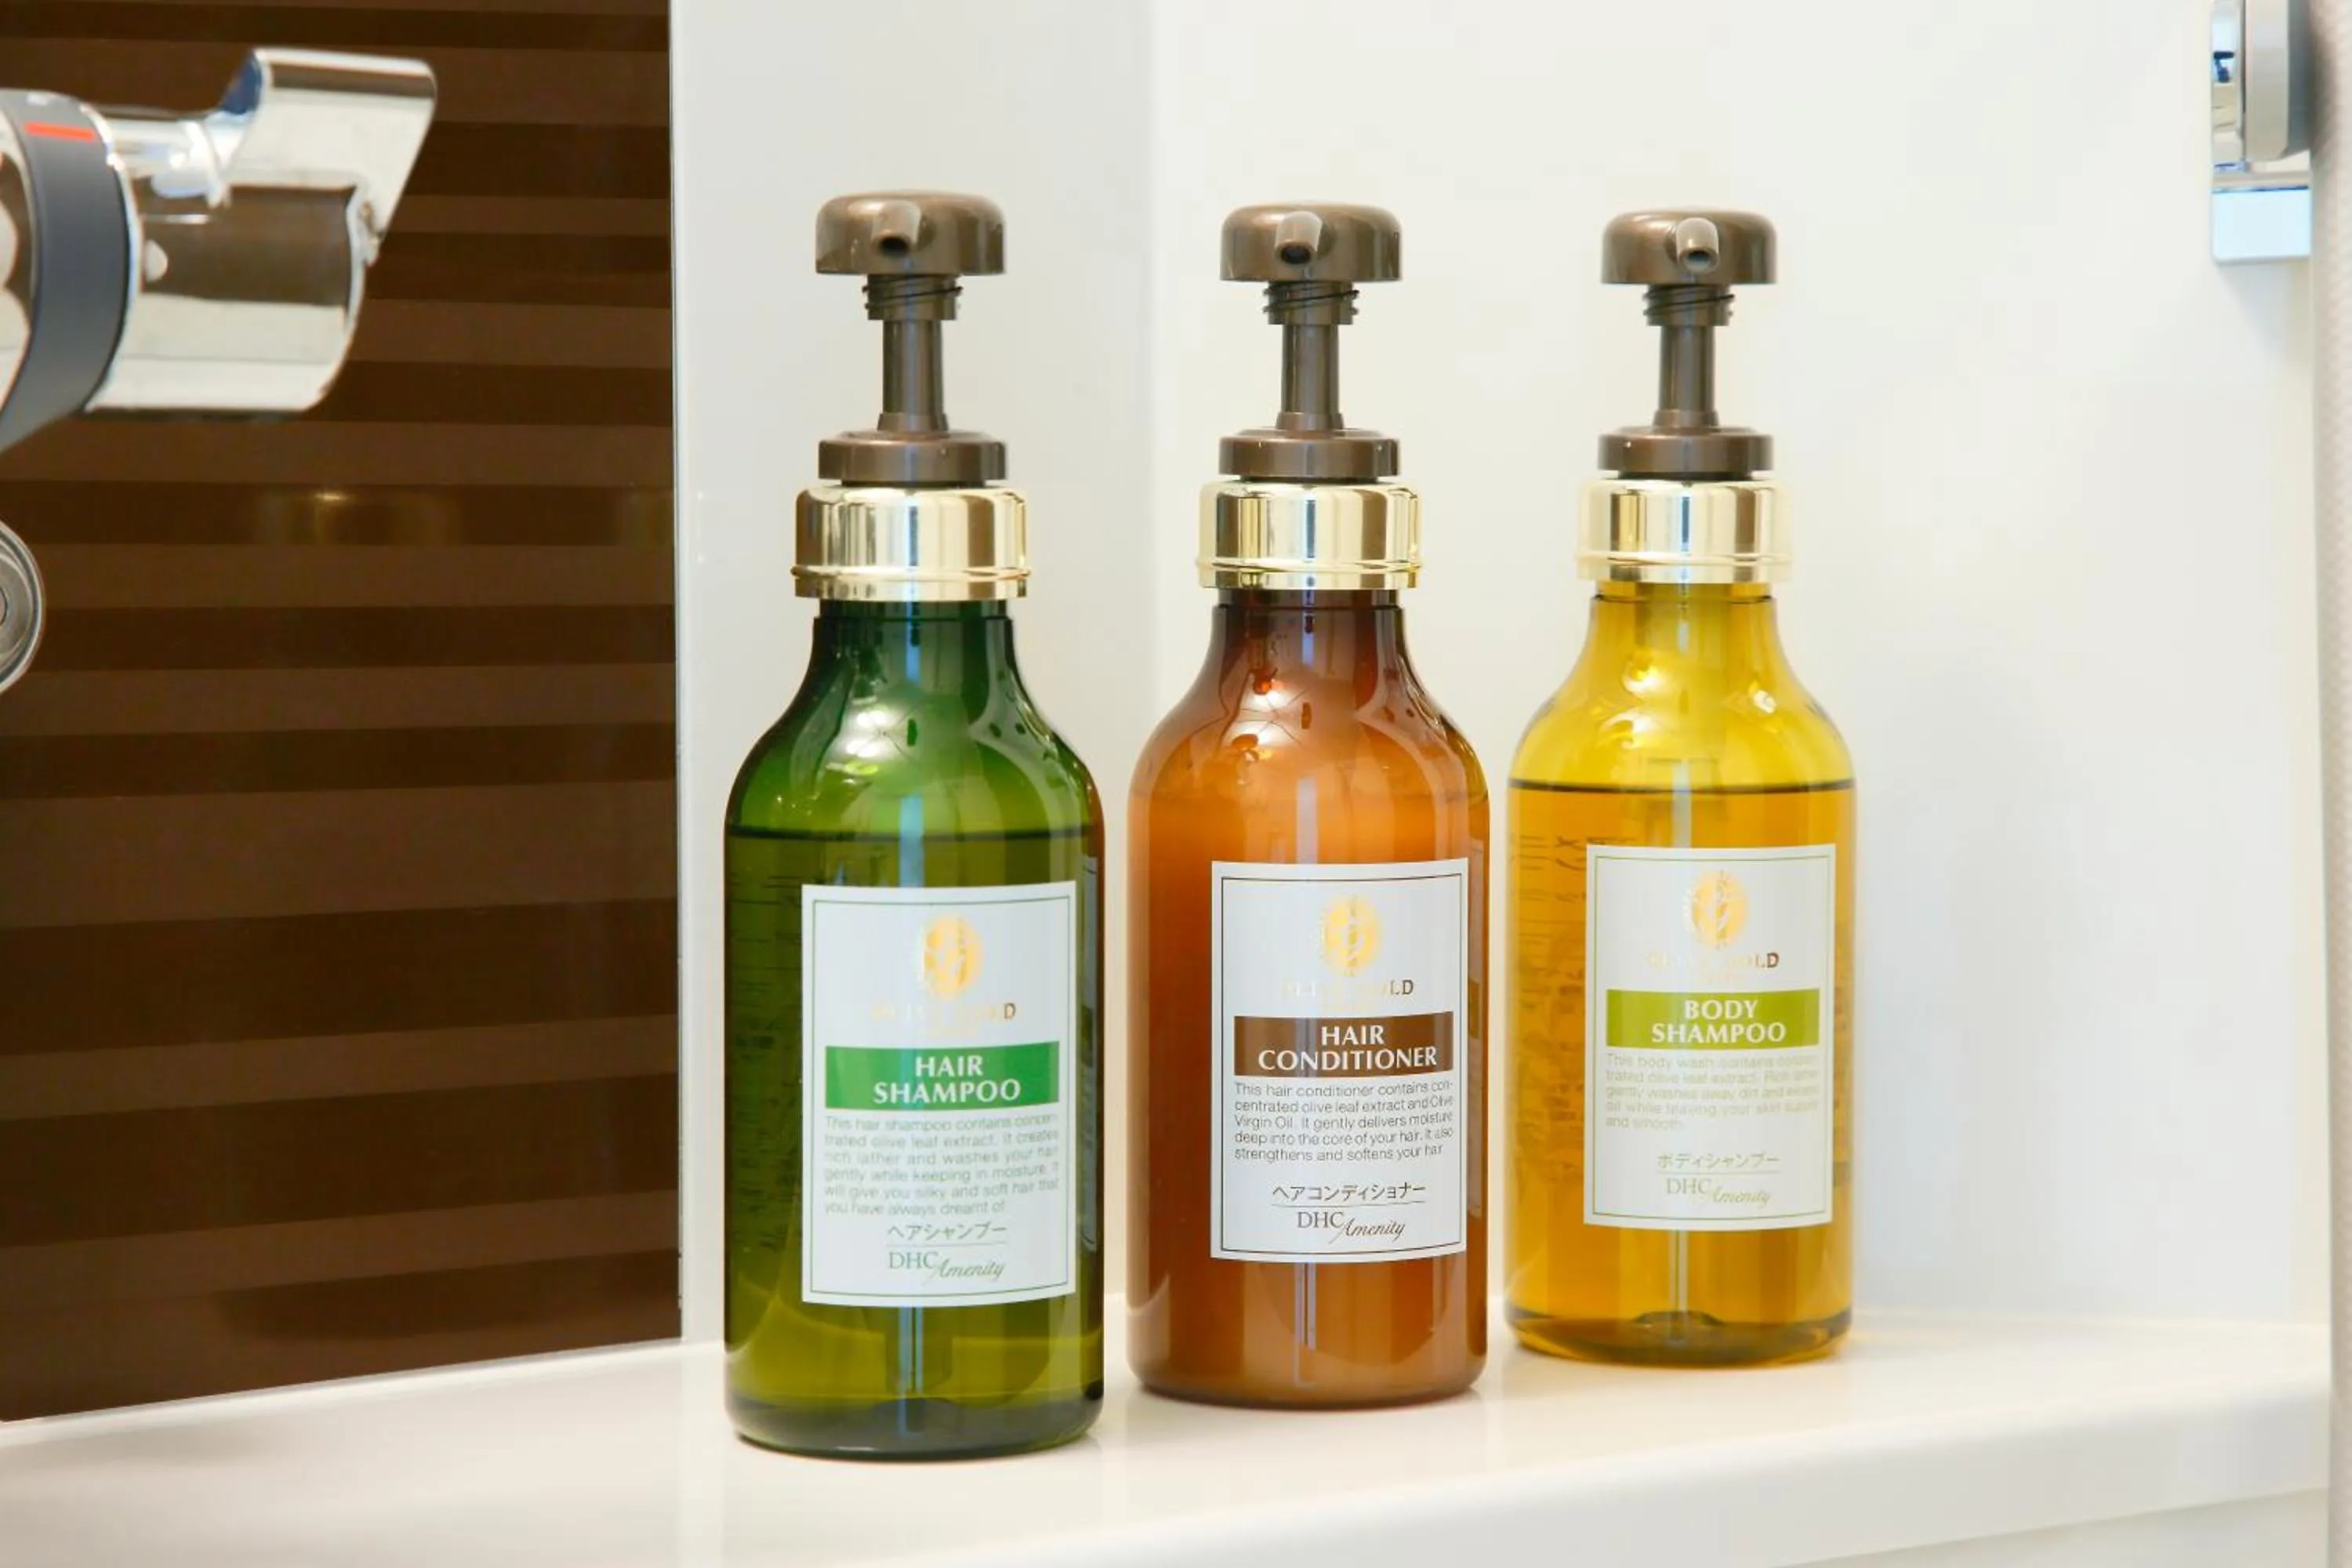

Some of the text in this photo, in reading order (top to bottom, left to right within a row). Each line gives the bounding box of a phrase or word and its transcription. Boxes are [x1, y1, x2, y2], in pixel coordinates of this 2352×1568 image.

[1685, 1000, 1759, 1019] BODY
[1321, 1025, 1385, 1045] HAIR
[1651, 1022, 1786, 1044] SHAMPOO
[915, 1055, 983, 1077] HAIR
[1258, 1046, 1437, 1070] CONDITIONER
[873, 1079, 1021, 1104] SHAMPOO
[1234, 1082, 1261, 1095] This
[1266, 1085, 1291, 1096] hair
[1296, 1085, 1374, 1098] conditioner
[1378, 1082, 1428, 1096] contains
[1235, 1100, 1298, 1113] centrated
[1301, 1101, 1332, 1113] olive
[1335, 1101, 1359, 1113] leaf
[1362, 1098, 1406, 1113] extract
[1409, 1096, 1427, 1109] and
[886, 1119, 952, 1132] shampoo
[956, 1116, 1011, 1131] contains
[1234, 1116, 1272, 1131] Virgin
[1313, 1116, 1355, 1133] gently
[1358, 1114, 1406, 1128] delivers
[1235, 1131, 1268, 1145] deep
[1298, 1133, 1319, 1145] the
[1370, 1134, 1396, 1145] your
[907, 1152, 936, 1166] and
[942, 1151, 998, 1165] washes
[1234, 1148, 1312, 1163] strengthens
[1316, 1149, 1344, 1161] and
[1347, 1145, 1392, 1161] softens
[1396, 1149, 1421, 1161] your
[1272, 1182, 1426, 1201] ヘアコンディショナー
[1666, 1178, 1711, 1194] DHC
[1297, 1211, 1405, 1243] DHC Amenity
[888, 1251, 938, 1269] DHC
